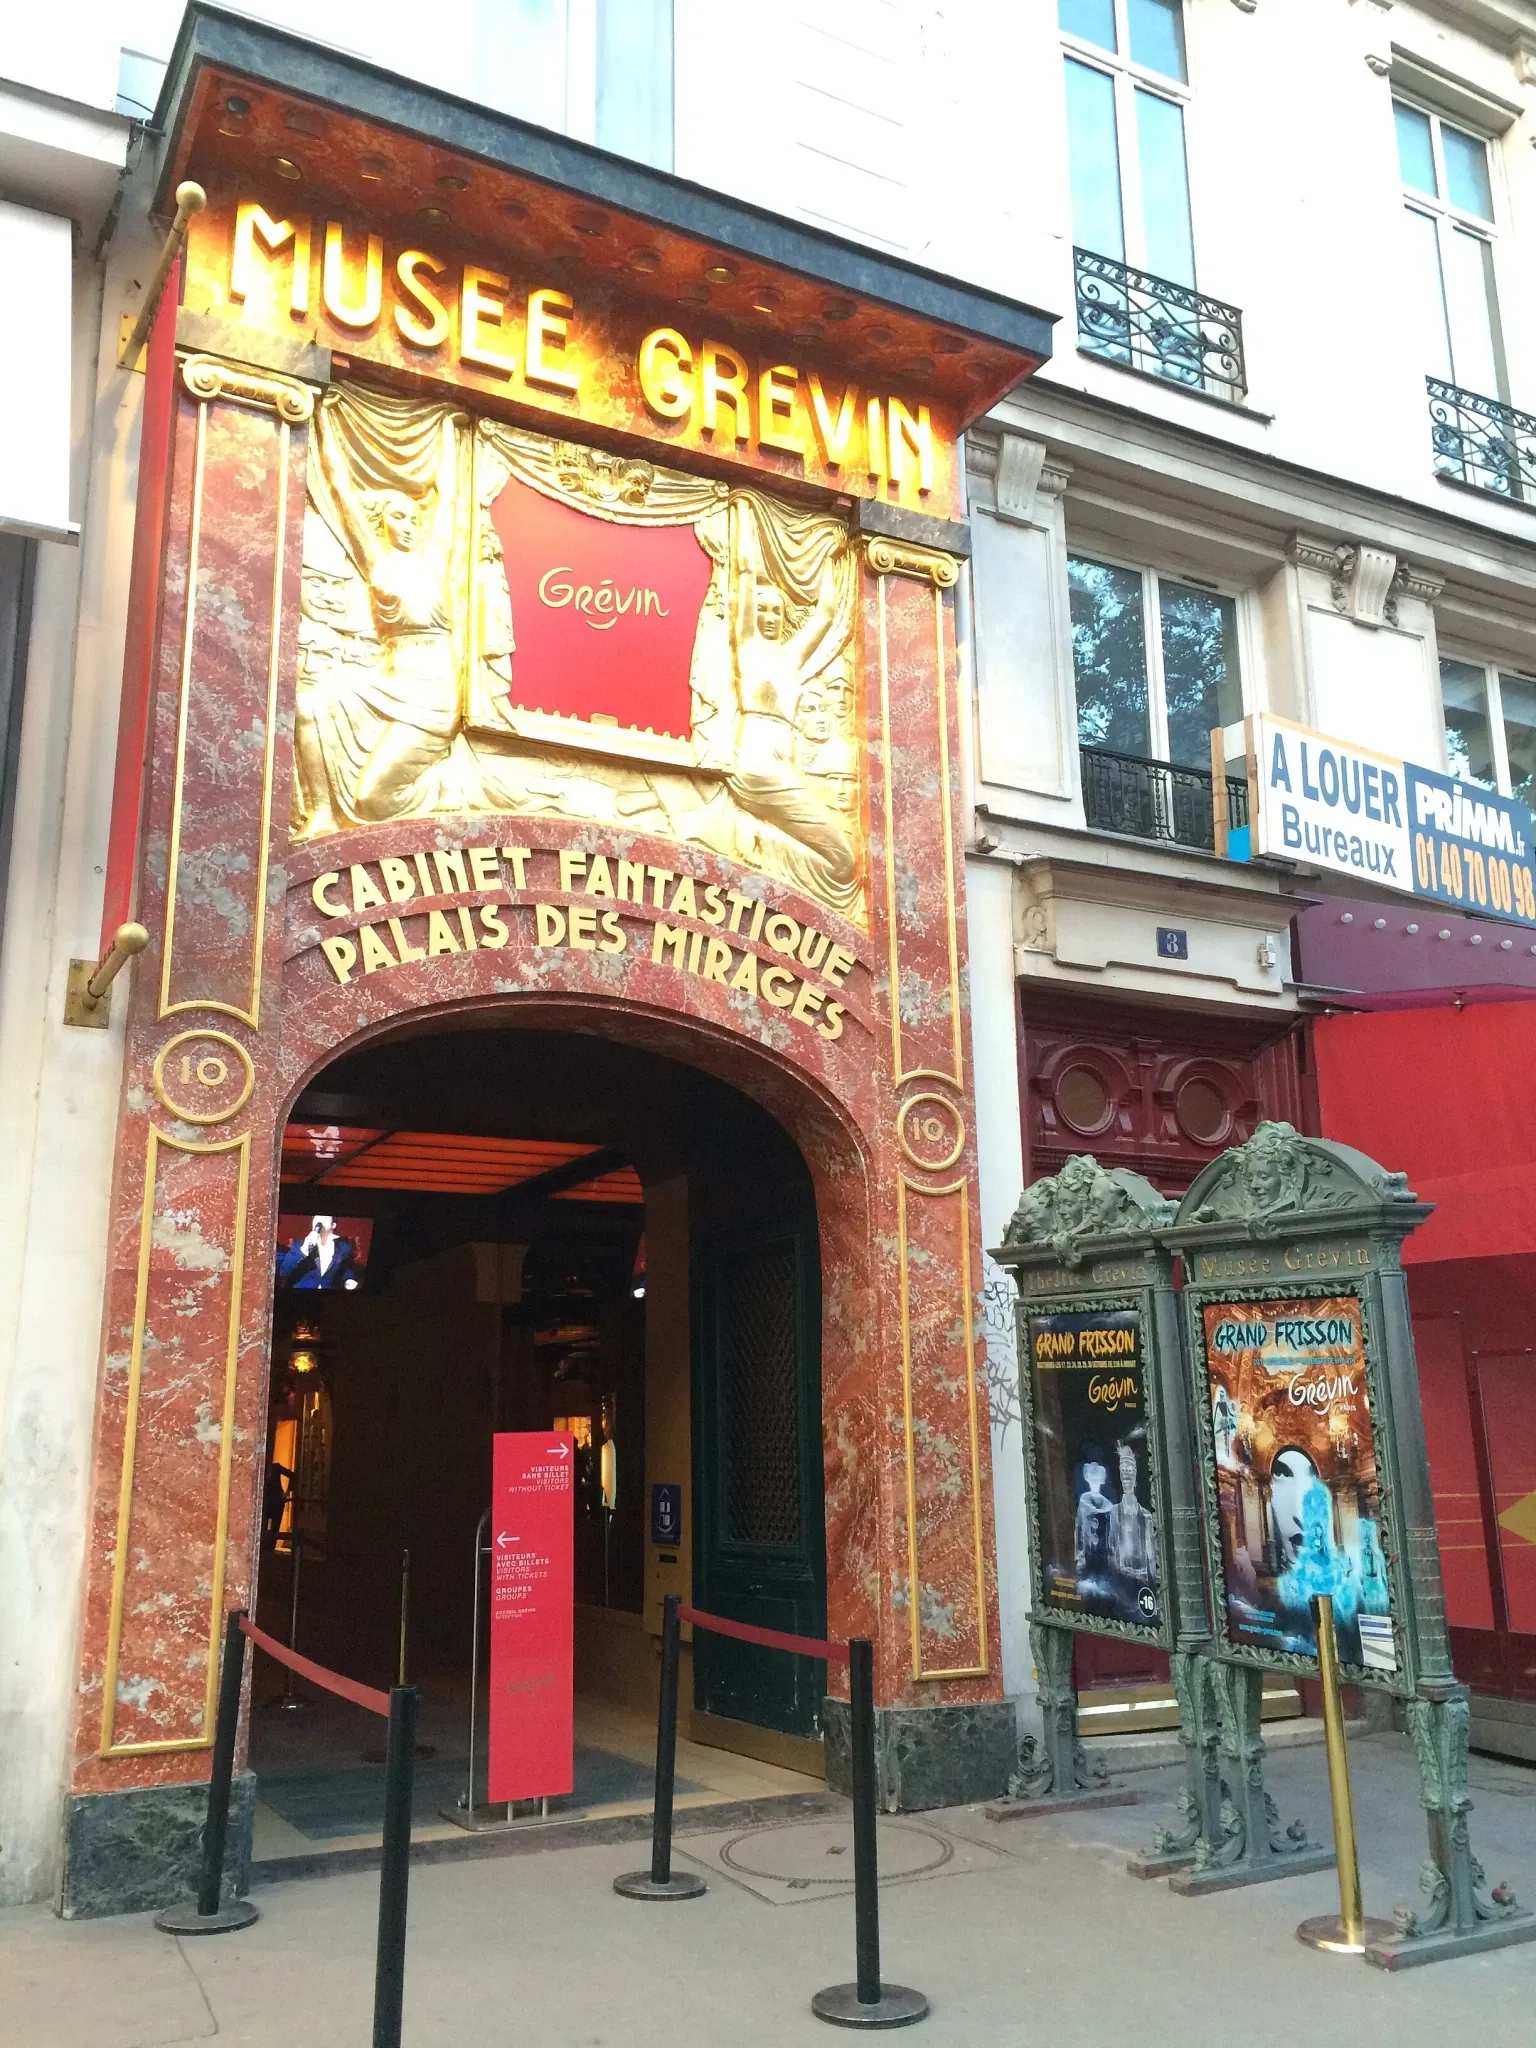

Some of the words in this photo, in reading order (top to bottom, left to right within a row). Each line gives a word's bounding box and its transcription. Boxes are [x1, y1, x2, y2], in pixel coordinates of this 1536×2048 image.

[229, 203, 581, 391] MUSEE
[638, 327, 932, 494] GREVIN
[538, 567, 670, 617] Grévin
[1271, 732, 1293, 794] A
[1300, 741, 1402, 829] LOUER
[1282, 803, 1397, 878] Bureaux
[1415, 832, 1437, 892] 01
[1440, 841, 1463, 899] 40
[1464, 851, 1487, 907] 70
[1489, 856, 1512, 914] 00
[1512, 866, 1536, 920] 98
[311, 846, 532, 919] CABINET
[559, 849, 858, 989] FANTASTIQUE
[320, 904, 510, 985] PALAIS
[535, 904, 628, 954] DES
[651, 921, 848, 1041] MIRAGES
[181, 1055, 228, 1086] 10
[912, 1116, 945, 1142] 10
[1036, 1331, 1075, 1360] GRAND
[1079, 1328, 1135, 1359] FRISSON
[1215, 1321, 1268, 1352] GRAND
[1274, 1318, 1353, 1352] FRISSON
[1088, 1374, 1138, 1404] Grévin
[1288, 1372, 1359, 1407] Grévin
[521, 1472, 541, 1480] SANS
[543, 1471, 569, 1479] BILLET
[530, 1465, 569, 1473] VISITEURS
[508, 1485, 541, 1493] WITHOUT
[496, 1553, 536, 1562] VISITEURS
[495, 1586, 532, 1594] GROUPES
[1139, 1595, 1154, 1611] -16
